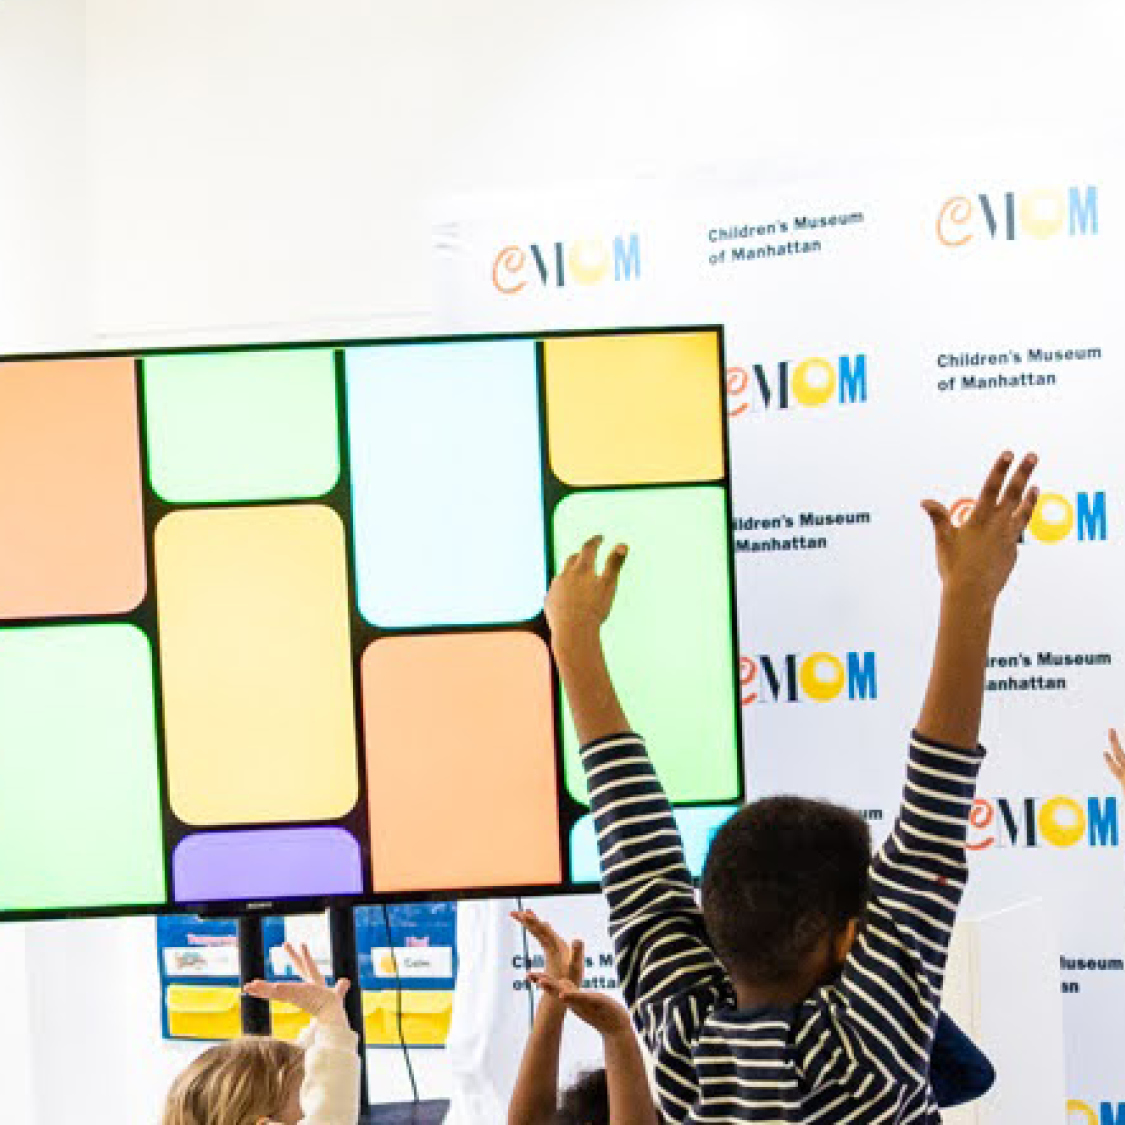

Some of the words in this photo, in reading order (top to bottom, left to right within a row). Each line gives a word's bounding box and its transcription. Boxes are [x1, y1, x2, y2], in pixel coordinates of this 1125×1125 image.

[935, 186, 1098, 247] CMOM
[709, 220, 788, 243] Children's
[793, 212, 864, 230] Museum
[709, 250, 725, 265] of
[732, 240, 821, 260] Manhattan
[493, 235, 640, 296] CMOM
[938, 352, 1022, 367] Children's
[1027, 349, 1101, 362] Museum
[938, 377, 956, 390] of
[961, 373, 1055, 388] Manhattan
[733, 515, 794, 534] ildren's
[800, 512, 869, 527] Museum
[736, 536, 827, 554] Manhattan
[1037, 652, 1111, 665] Museum
[986, 675, 1066, 692] anhattan
